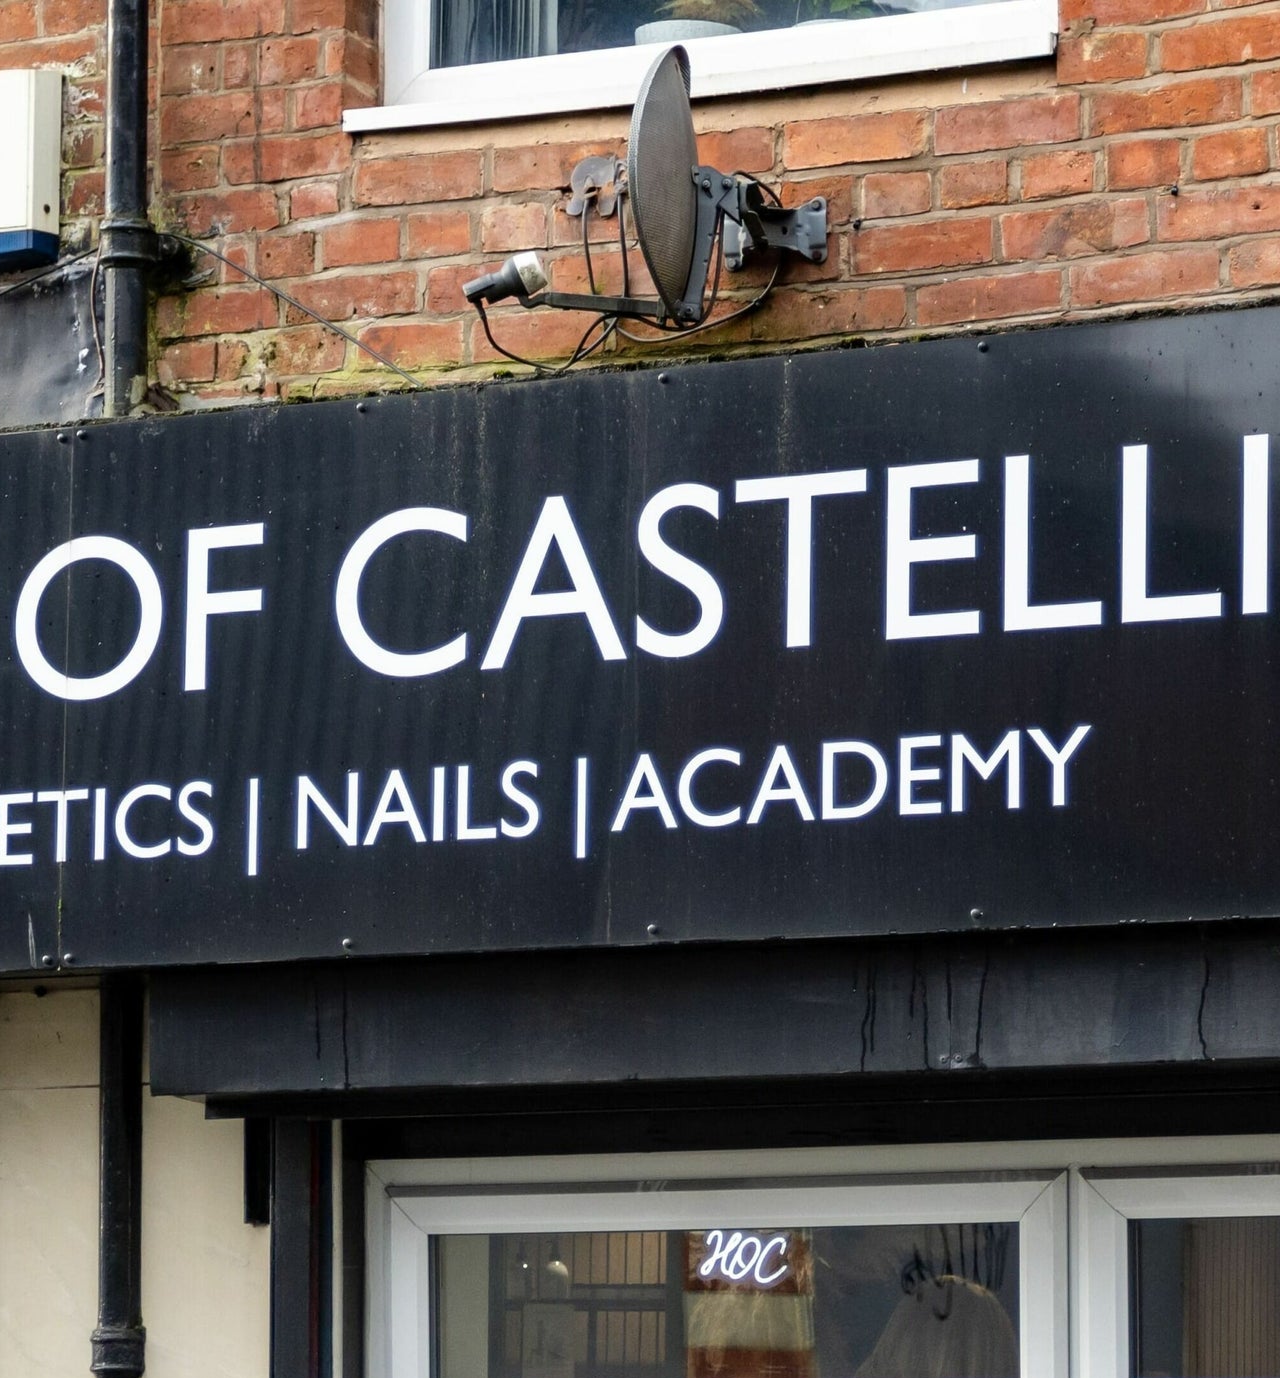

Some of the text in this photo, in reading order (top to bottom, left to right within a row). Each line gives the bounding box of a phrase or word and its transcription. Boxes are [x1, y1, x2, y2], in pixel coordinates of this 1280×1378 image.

[14, 522, 265, 701] OF
[296, 760, 540, 850] NAILS
[610, 724, 1092, 832] ACADEMY
